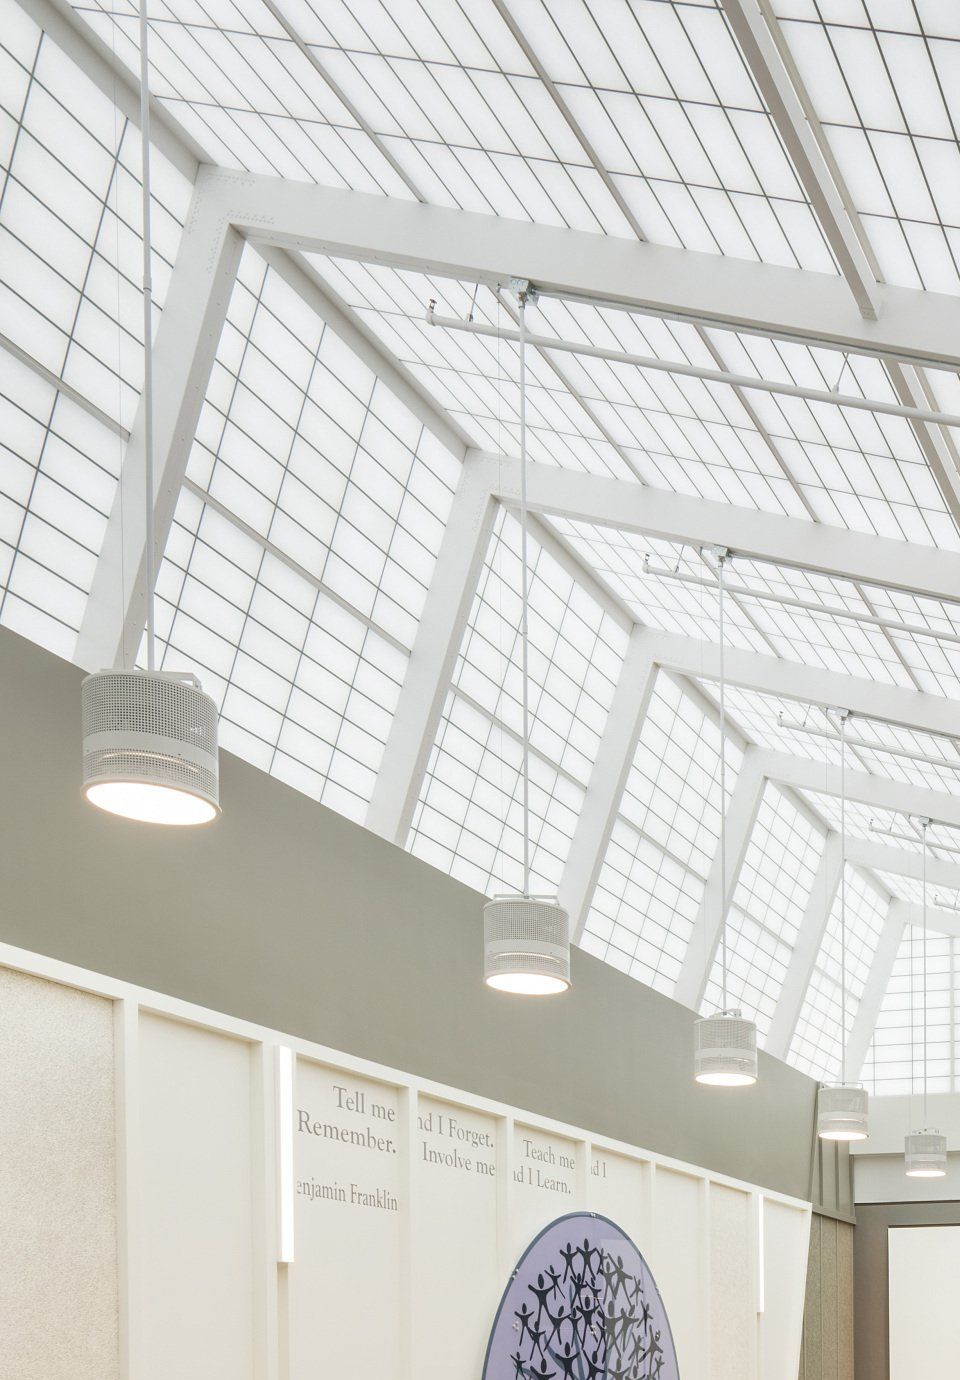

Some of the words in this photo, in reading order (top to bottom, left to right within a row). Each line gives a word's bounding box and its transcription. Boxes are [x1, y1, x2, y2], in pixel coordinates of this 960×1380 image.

[297, 1109, 396, 1154] Remember.
[423, 1141, 472, 1171] Involve
[476, 1161, 496, 1176] me
[528, 1167, 533, 1185] I
[537, 1170, 571, 1194] Learn.
[333, 1085, 365, 1114] Tell
[371, 1103, 396, 1122] me
[417, 1112, 433, 1132] nd
[438, 1115, 444, 1136] I
[448, 1118, 494, 1148] Forget.
[523, 1139, 556, 1165] Teach
[559, 1155, 575, 1170] me
[296, 1177, 347, 1202] enjamin
[350, 1183, 398, 1211] Franklin
